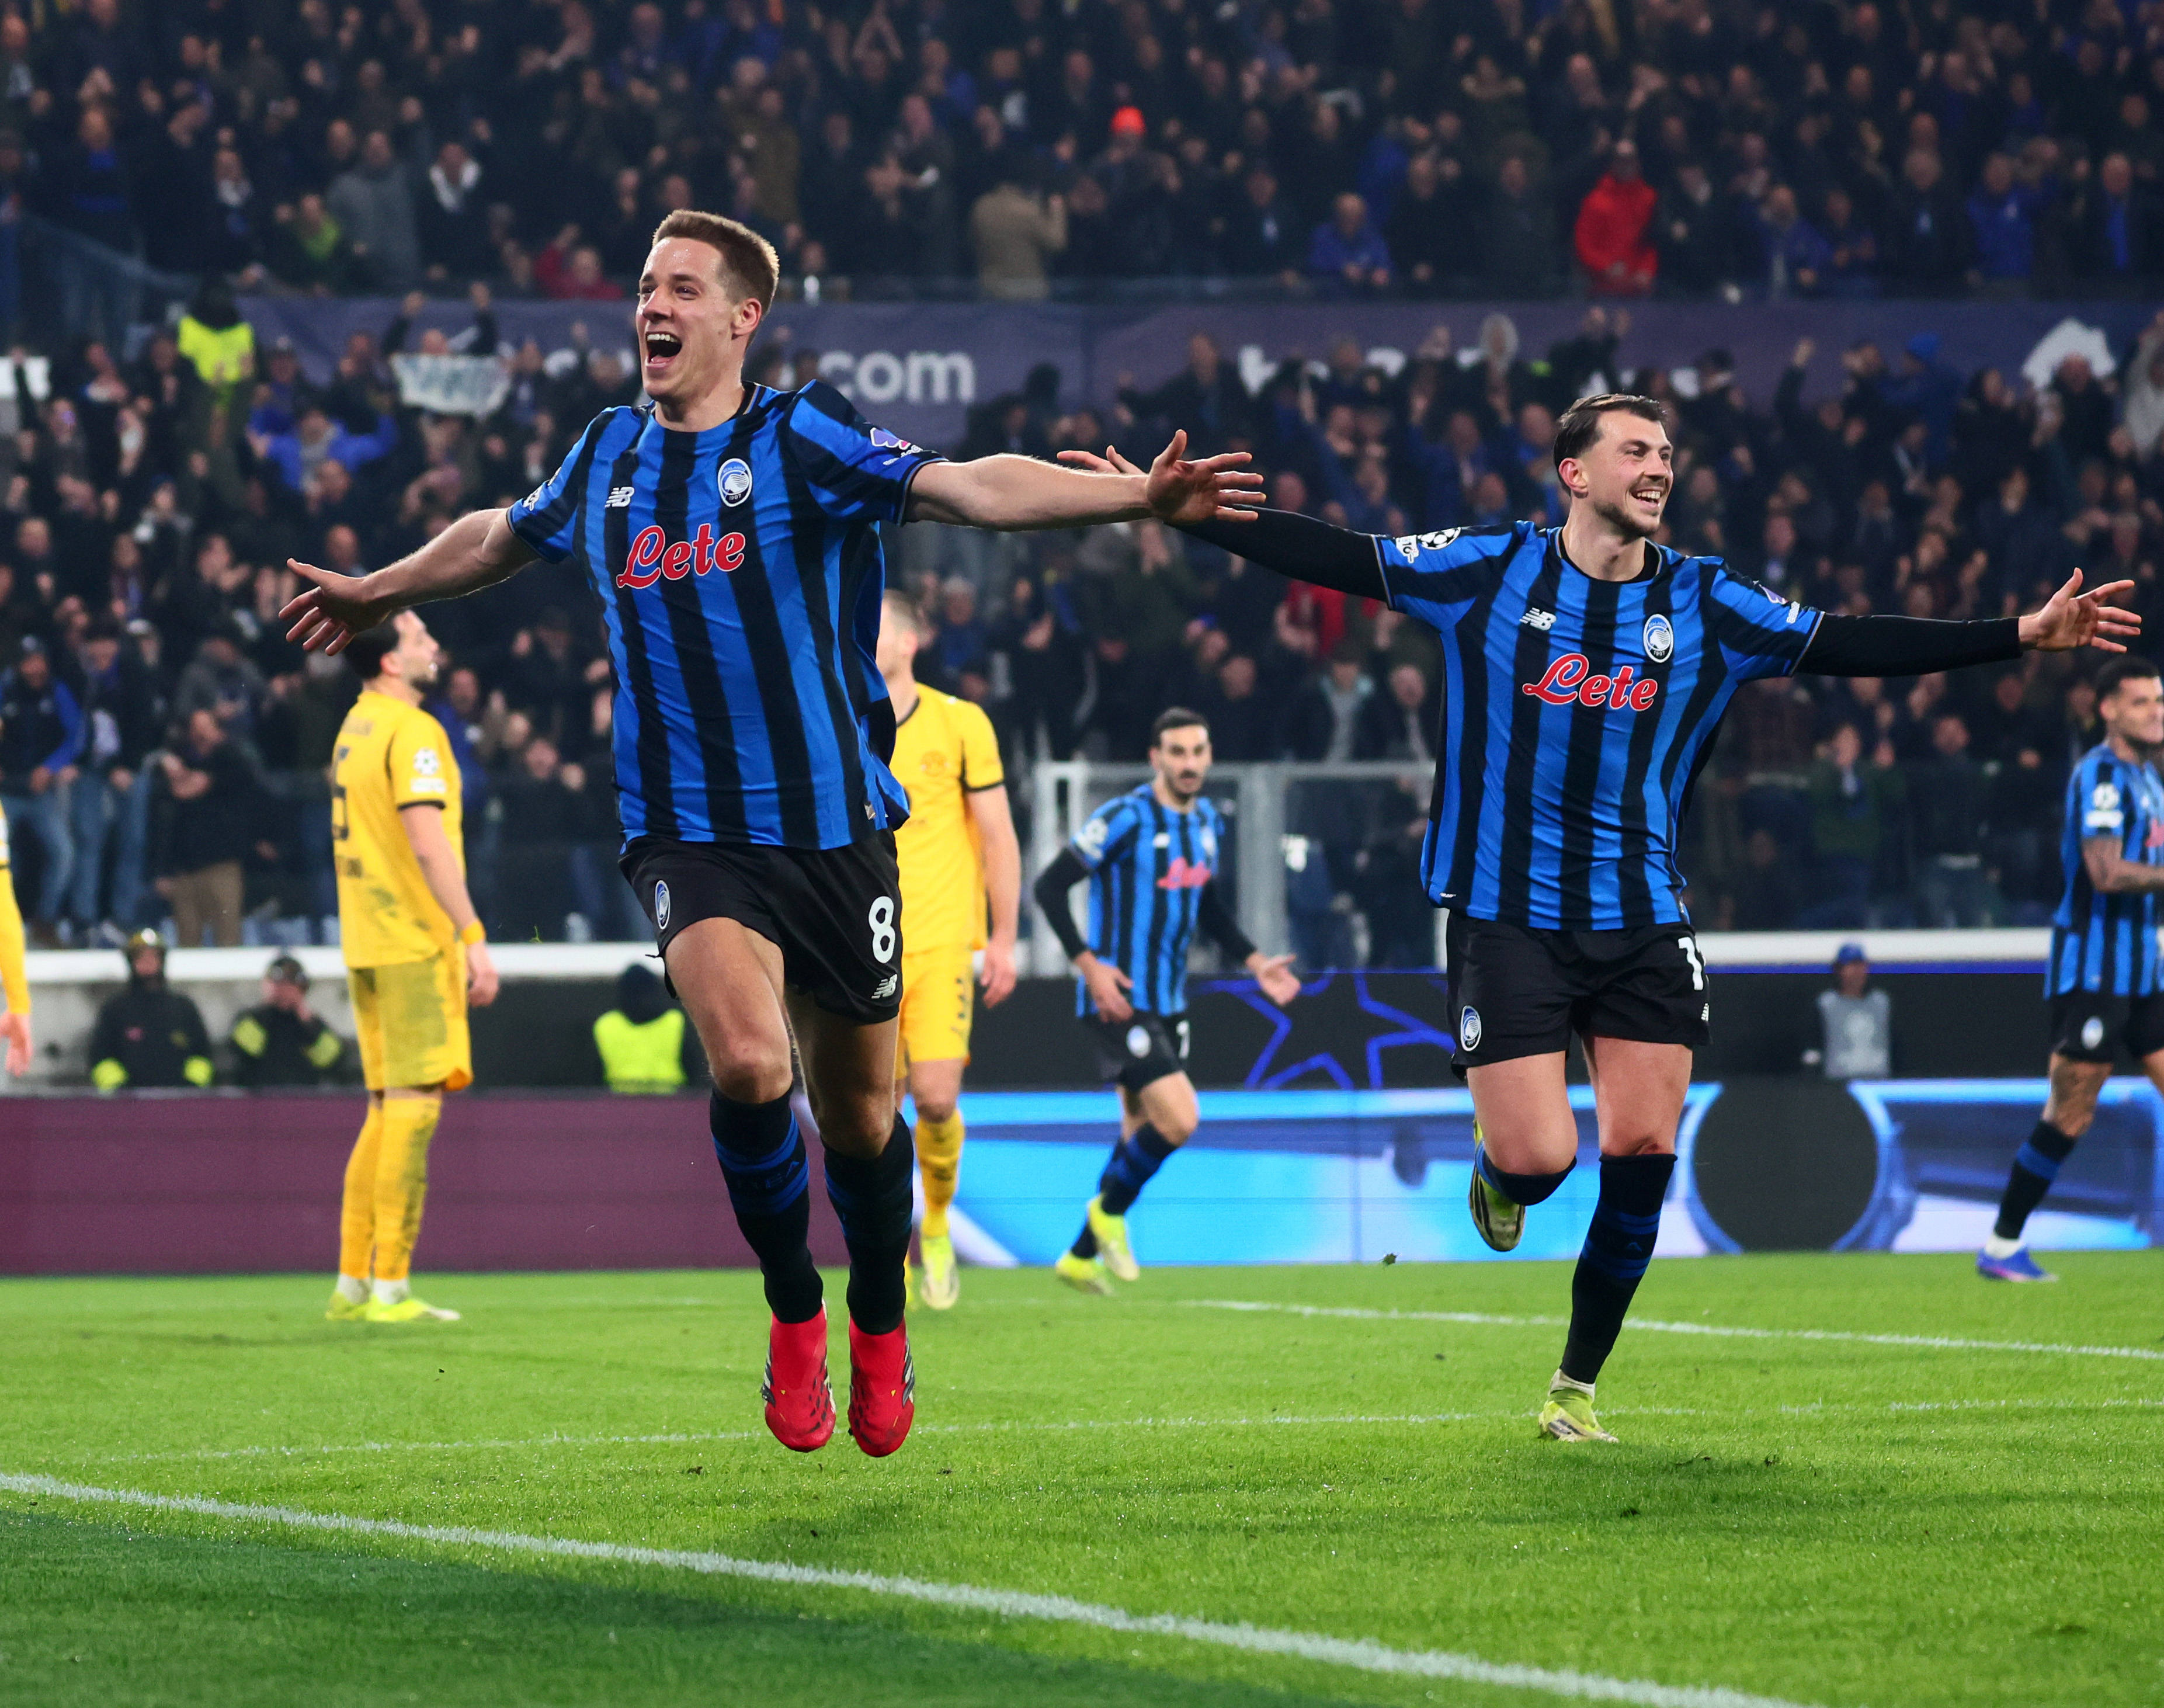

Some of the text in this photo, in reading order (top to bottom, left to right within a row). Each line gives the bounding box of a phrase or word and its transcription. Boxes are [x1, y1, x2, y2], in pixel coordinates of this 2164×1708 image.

[616, 523, 746, 589] Lete
[1522, 652, 1658, 711] Lete
[869, 895, 896, 964] 8
